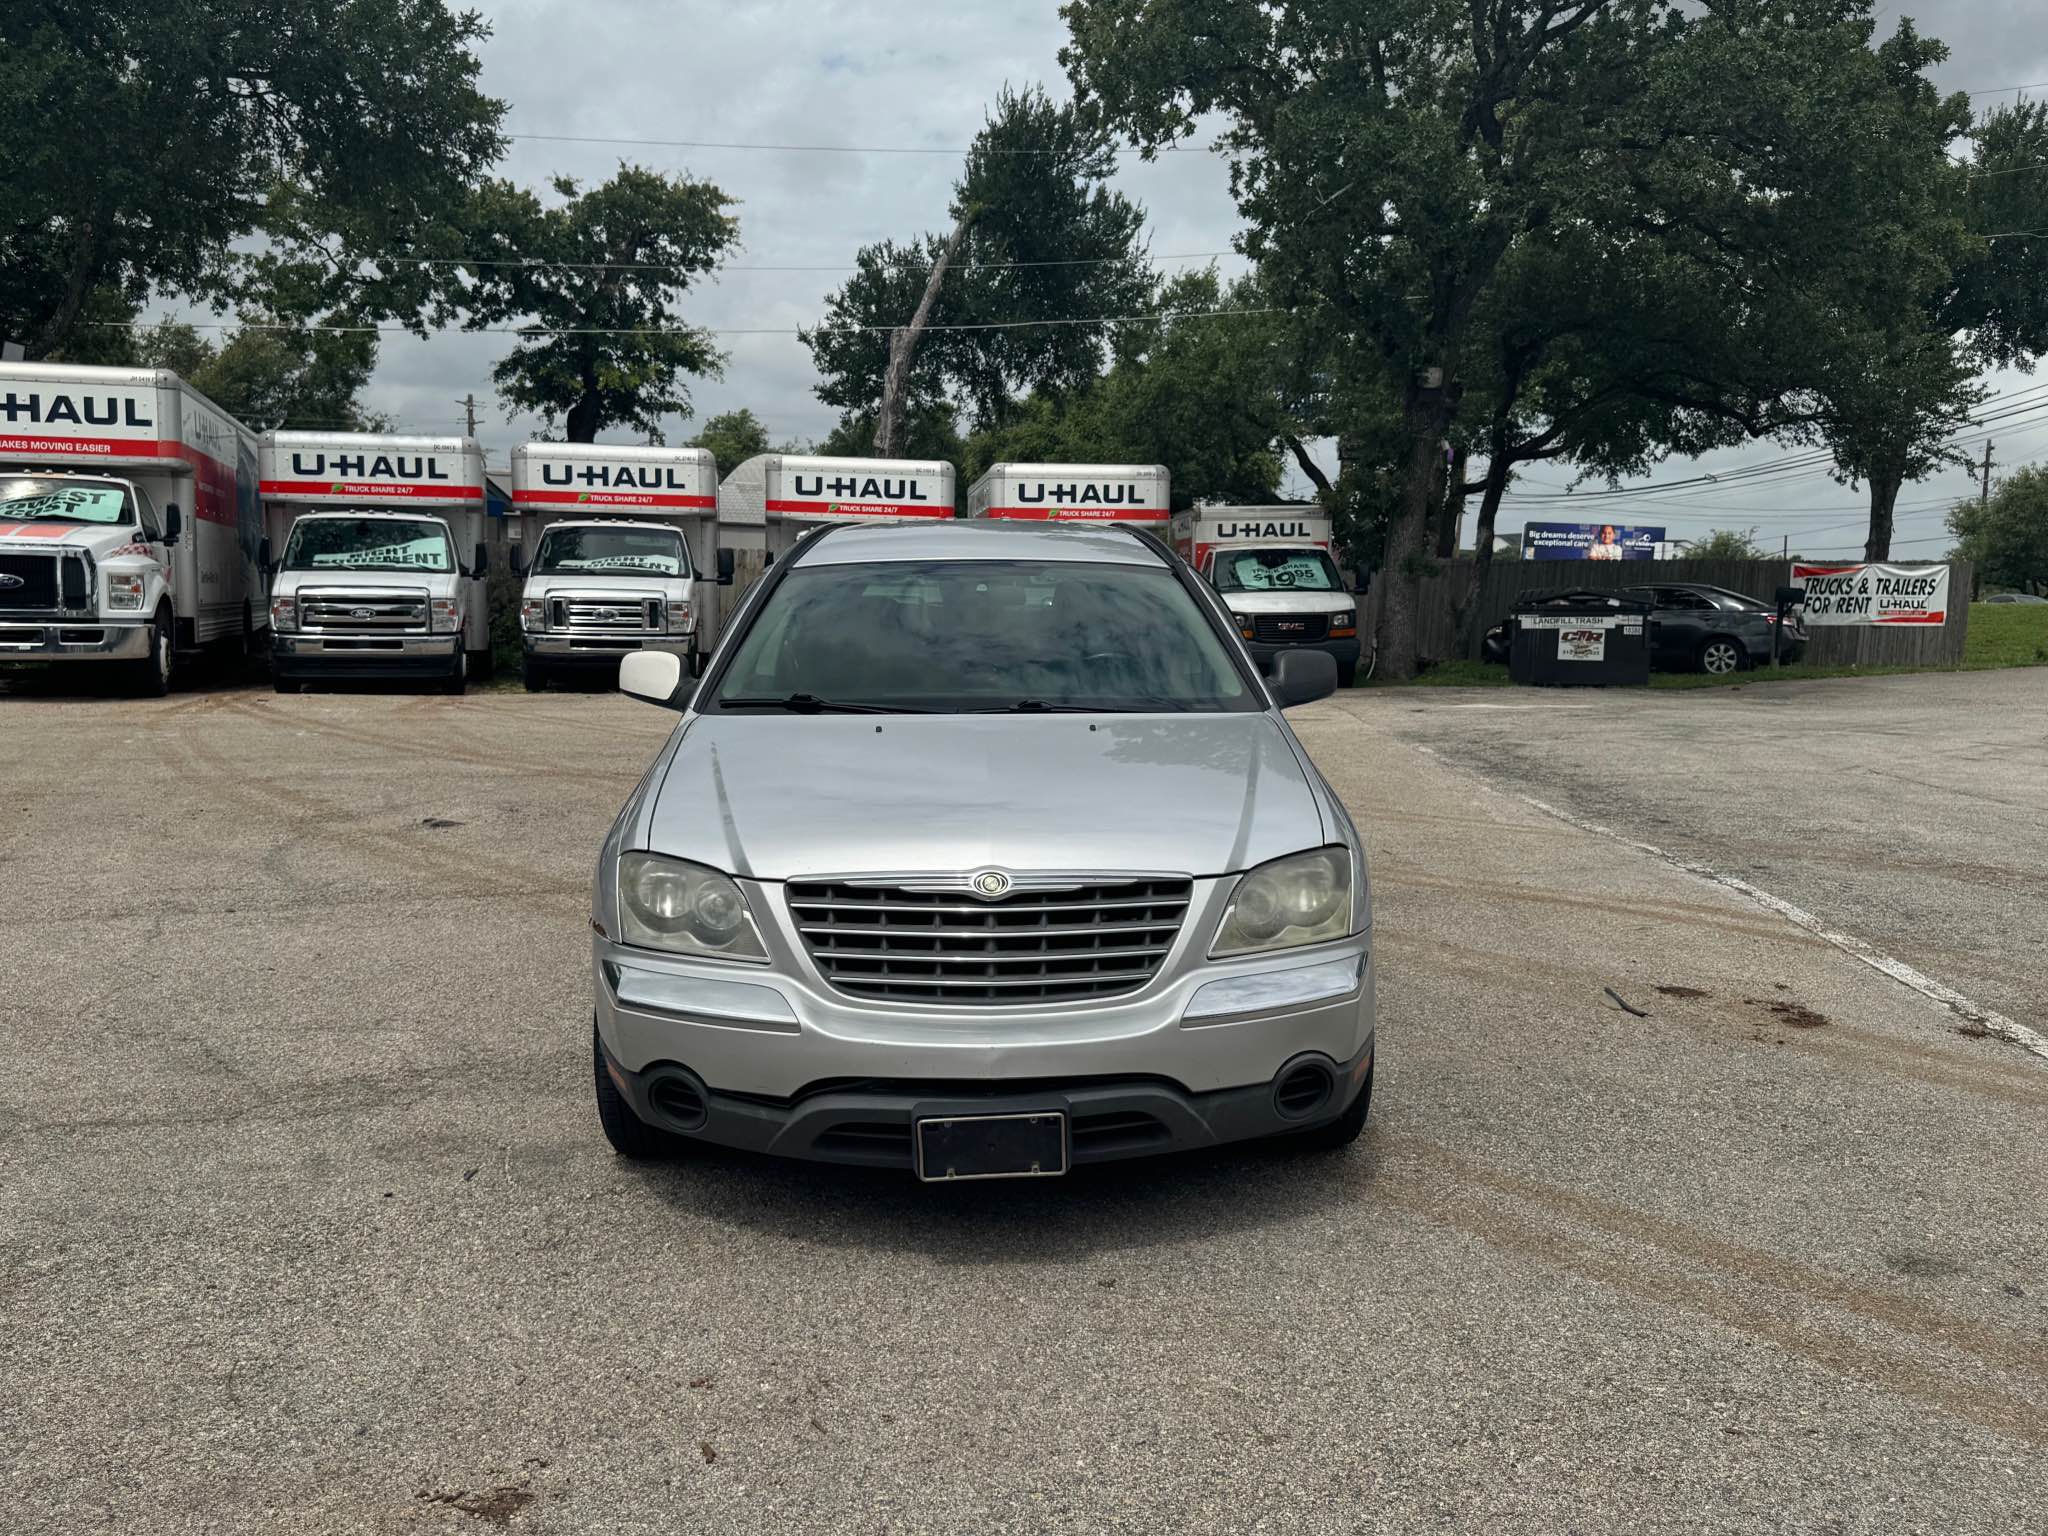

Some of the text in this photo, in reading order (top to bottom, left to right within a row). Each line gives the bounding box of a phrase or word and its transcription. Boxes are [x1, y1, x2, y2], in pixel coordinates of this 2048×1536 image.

[30, 441, 73, 452] MOVING
[75, 443, 111, 453] EASIER
[292, 453, 448, 479] U-HAUL
[543, 464, 685, 489] U-HAUL
[344, 485, 414, 494] TRUCK SHARE 24/7
[795, 475, 927, 500] U-HAUL
[1018, 483, 1145, 504] U-HAUL
[590, 494, 653, 504] TRUCK SHARE 24/7
[1218, 522, 1311, 538] U-HAUL
[1529, 530, 1595, 540] Big dreams deserve
[1533, 539, 1573, 547] exceptional
[1804, 578, 1936, 596] TRUCKS & TRAILERS
[1802, 597, 1830, 614] FOR
[1835, 597, 1872, 614] RENT
[1879, 599, 1927, 609] U-HAUL
[1574, 617, 1603, 625] TRASH
